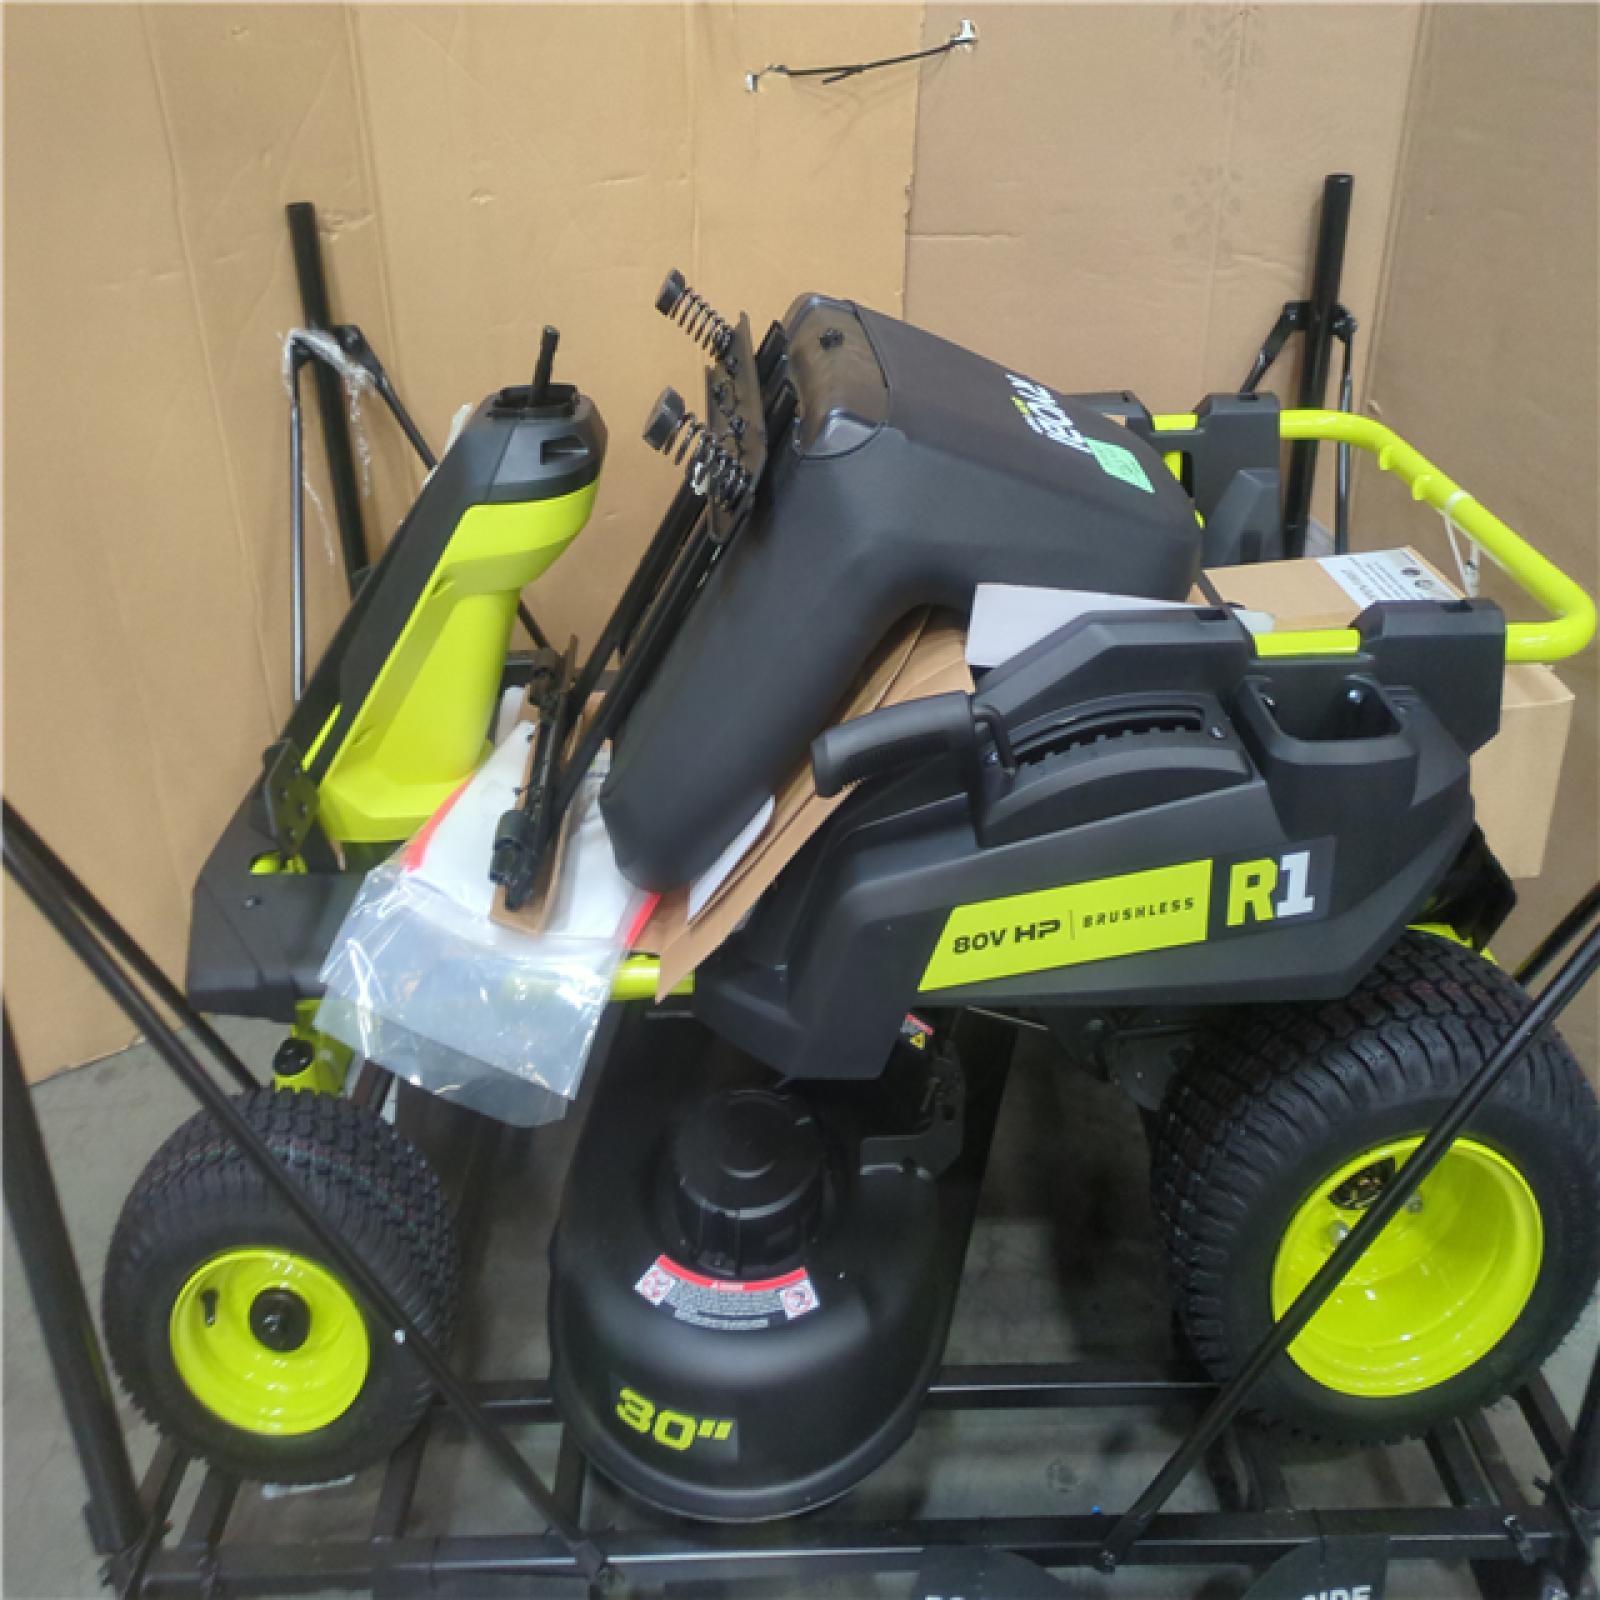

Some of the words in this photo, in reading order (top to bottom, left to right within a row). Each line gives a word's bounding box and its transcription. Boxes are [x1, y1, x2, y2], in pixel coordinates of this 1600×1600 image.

[1227, 850, 1316, 928] R1
[953, 927, 1007, 954] 80V
[1014, 919, 1061, 943] HP
[1082, 897, 1195, 929] BRUSHLESS
[616, 1386, 733, 1452] 30"
